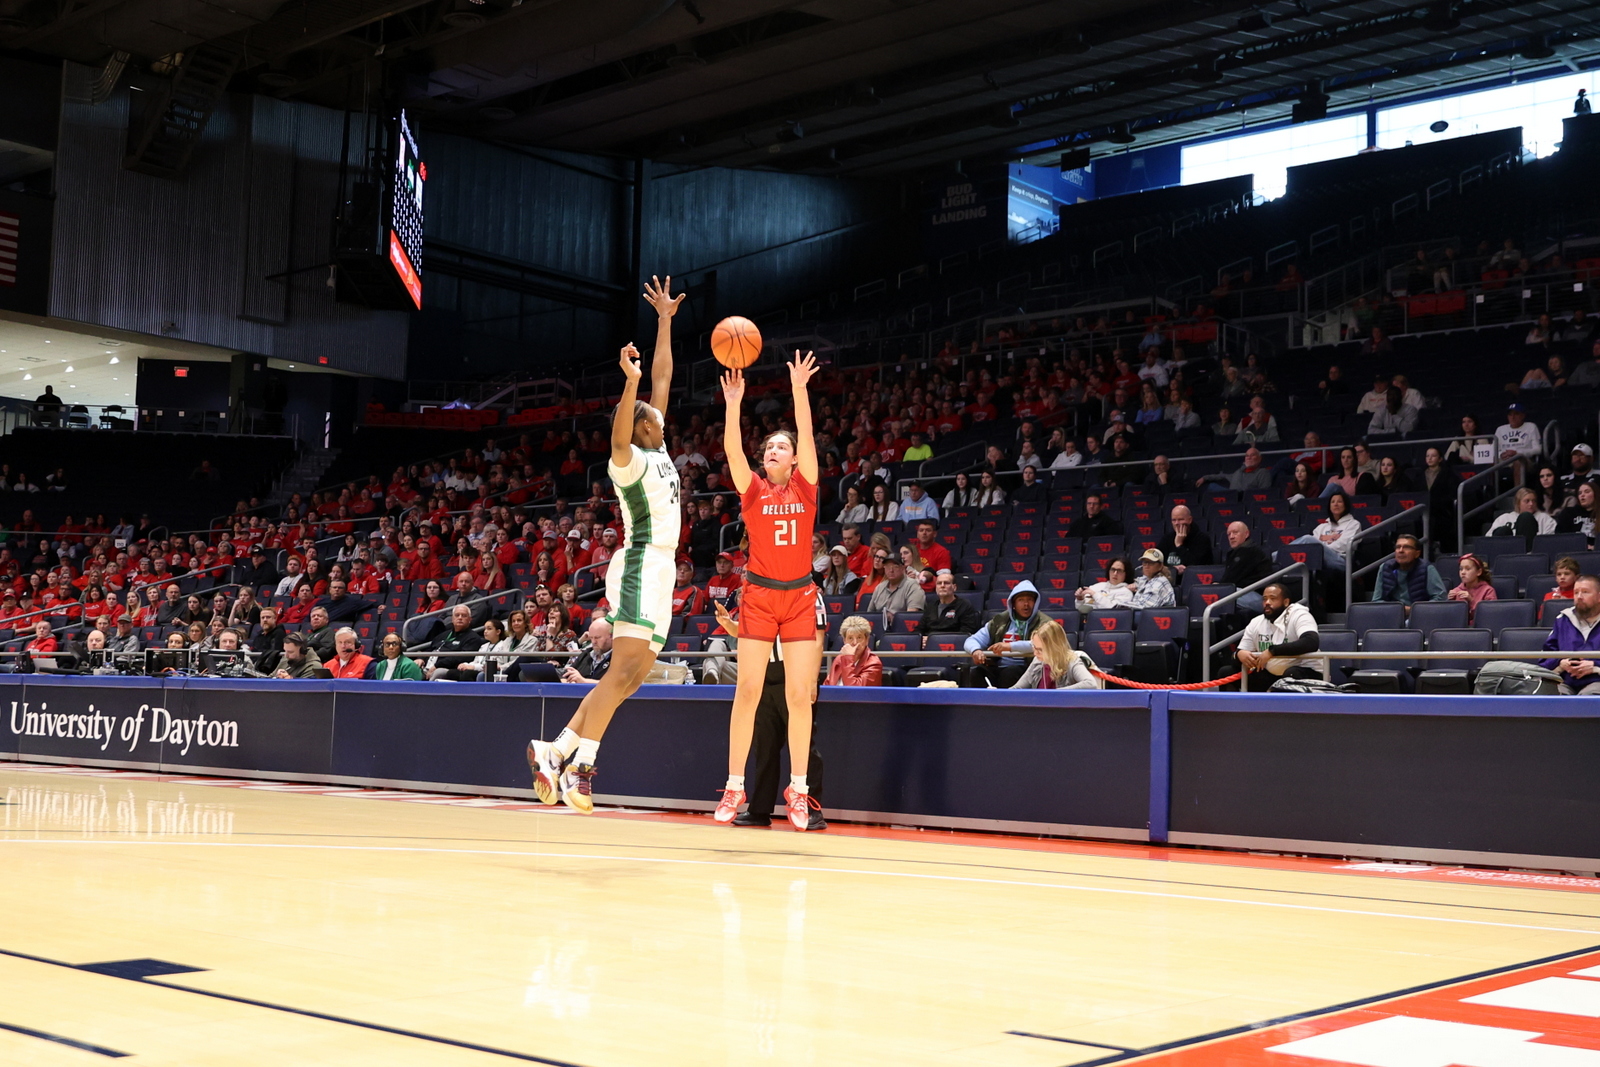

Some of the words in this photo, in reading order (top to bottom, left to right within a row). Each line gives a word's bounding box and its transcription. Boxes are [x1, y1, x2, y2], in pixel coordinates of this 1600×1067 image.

[947, 183, 973, 197] BUD
[941, 193, 977, 209] LIGHT
[932, 205, 987, 225] LANDING
[1502, 430, 1528, 441] DUKE
[1477, 450, 1490, 458] 113
[669, 479, 679, 504] 24
[762, 503, 806, 515] BELLEVUE
[773, 519, 798, 547] 21
[10, 701, 117, 752] University
[120, 704, 149, 753] of
[150, 707, 239, 757] Dayton
